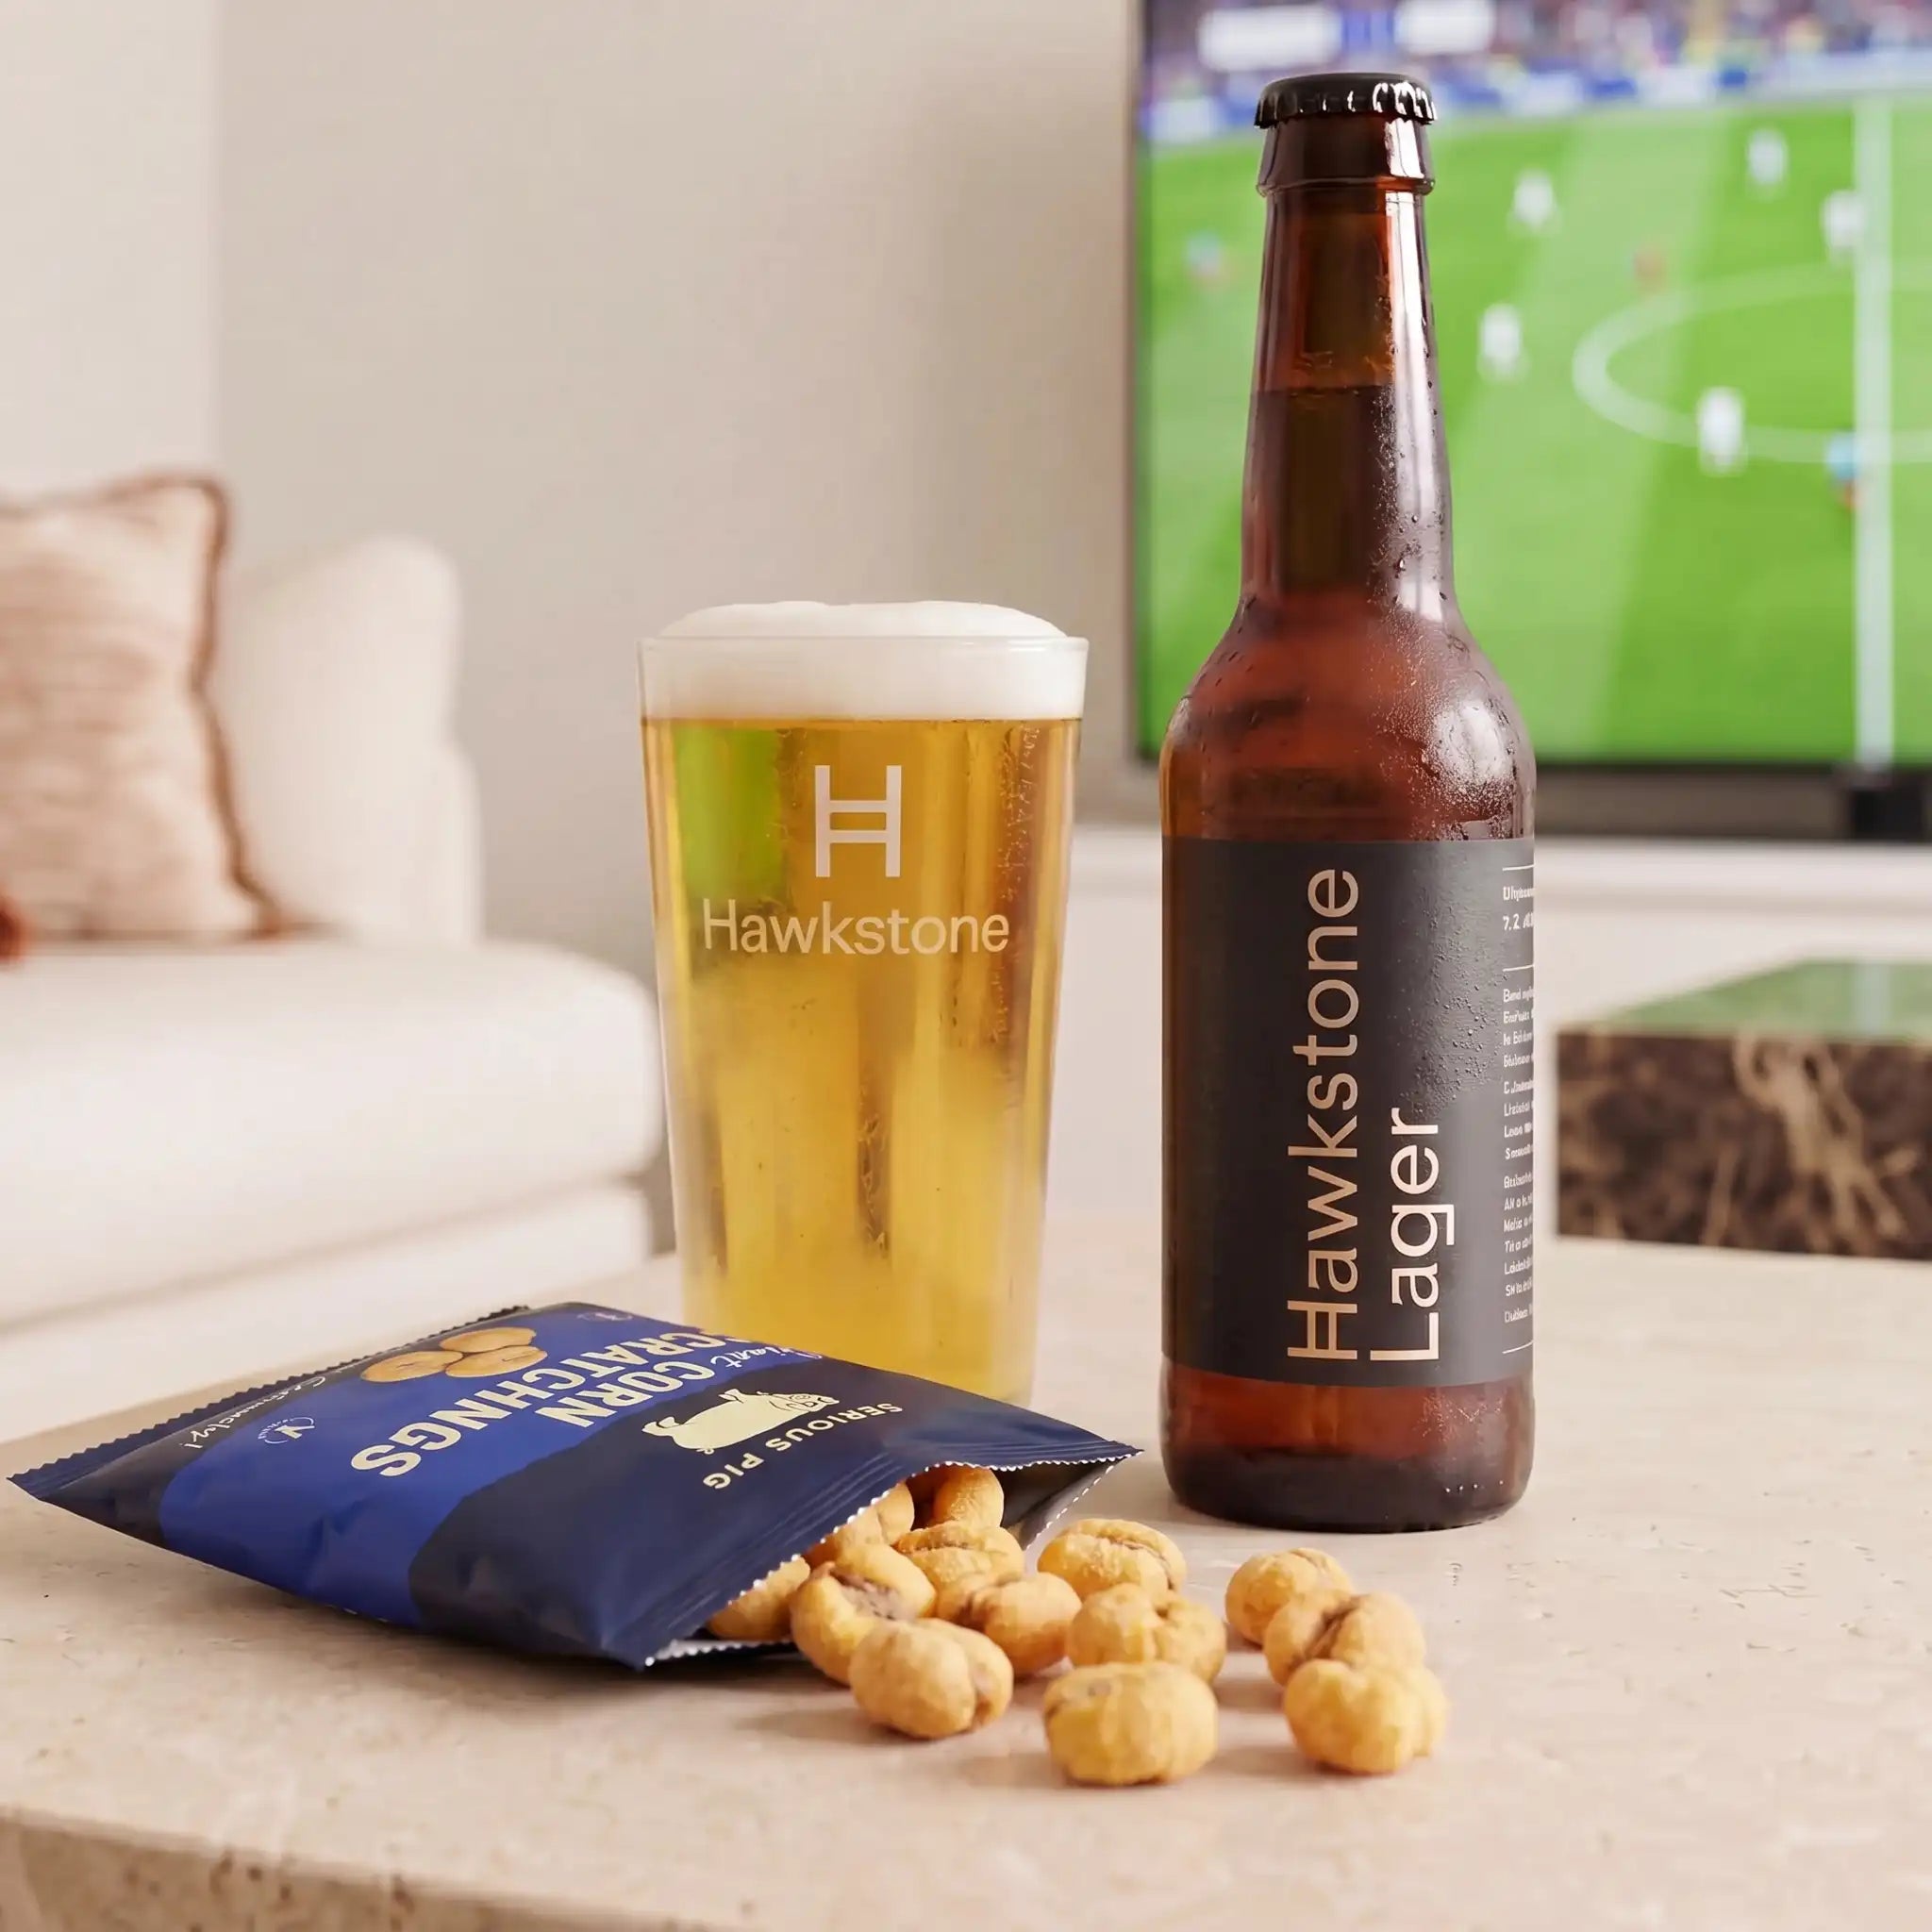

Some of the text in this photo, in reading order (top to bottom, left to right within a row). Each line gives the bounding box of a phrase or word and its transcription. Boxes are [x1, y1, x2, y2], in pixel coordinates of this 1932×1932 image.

[703, 898, 1009, 955] Hawkstone
[1288, 869, 1359, 1360] Hawkstone
[1370, 1108, 1455, 1361] Lager
[536, 1360, 715, 1428] CORN
[702, 1402, 903, 1491] SERIOUS PIG
